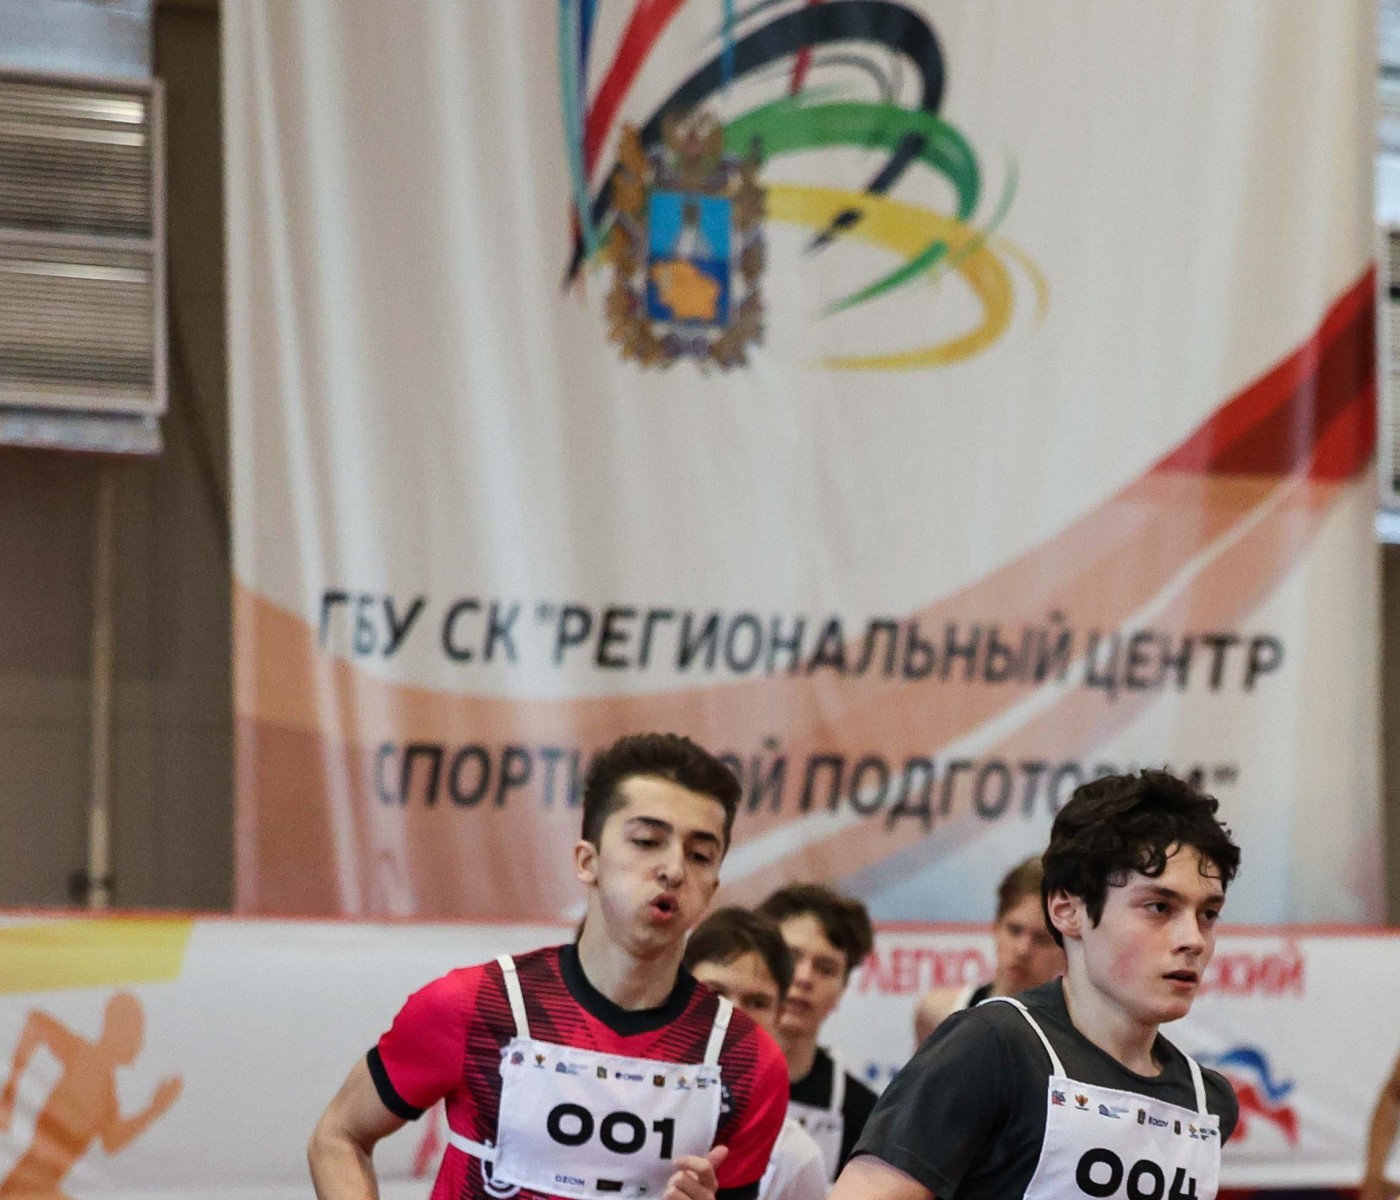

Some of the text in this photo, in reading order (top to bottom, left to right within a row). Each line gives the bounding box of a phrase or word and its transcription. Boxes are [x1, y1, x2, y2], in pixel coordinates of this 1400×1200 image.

[317, 588, 428, 657] ГБУ
[439, 597, 520, 666] СК
[1083, 628, 1285, 698] ЦЕНТР
[547, 1103, 675, 1160] 001
